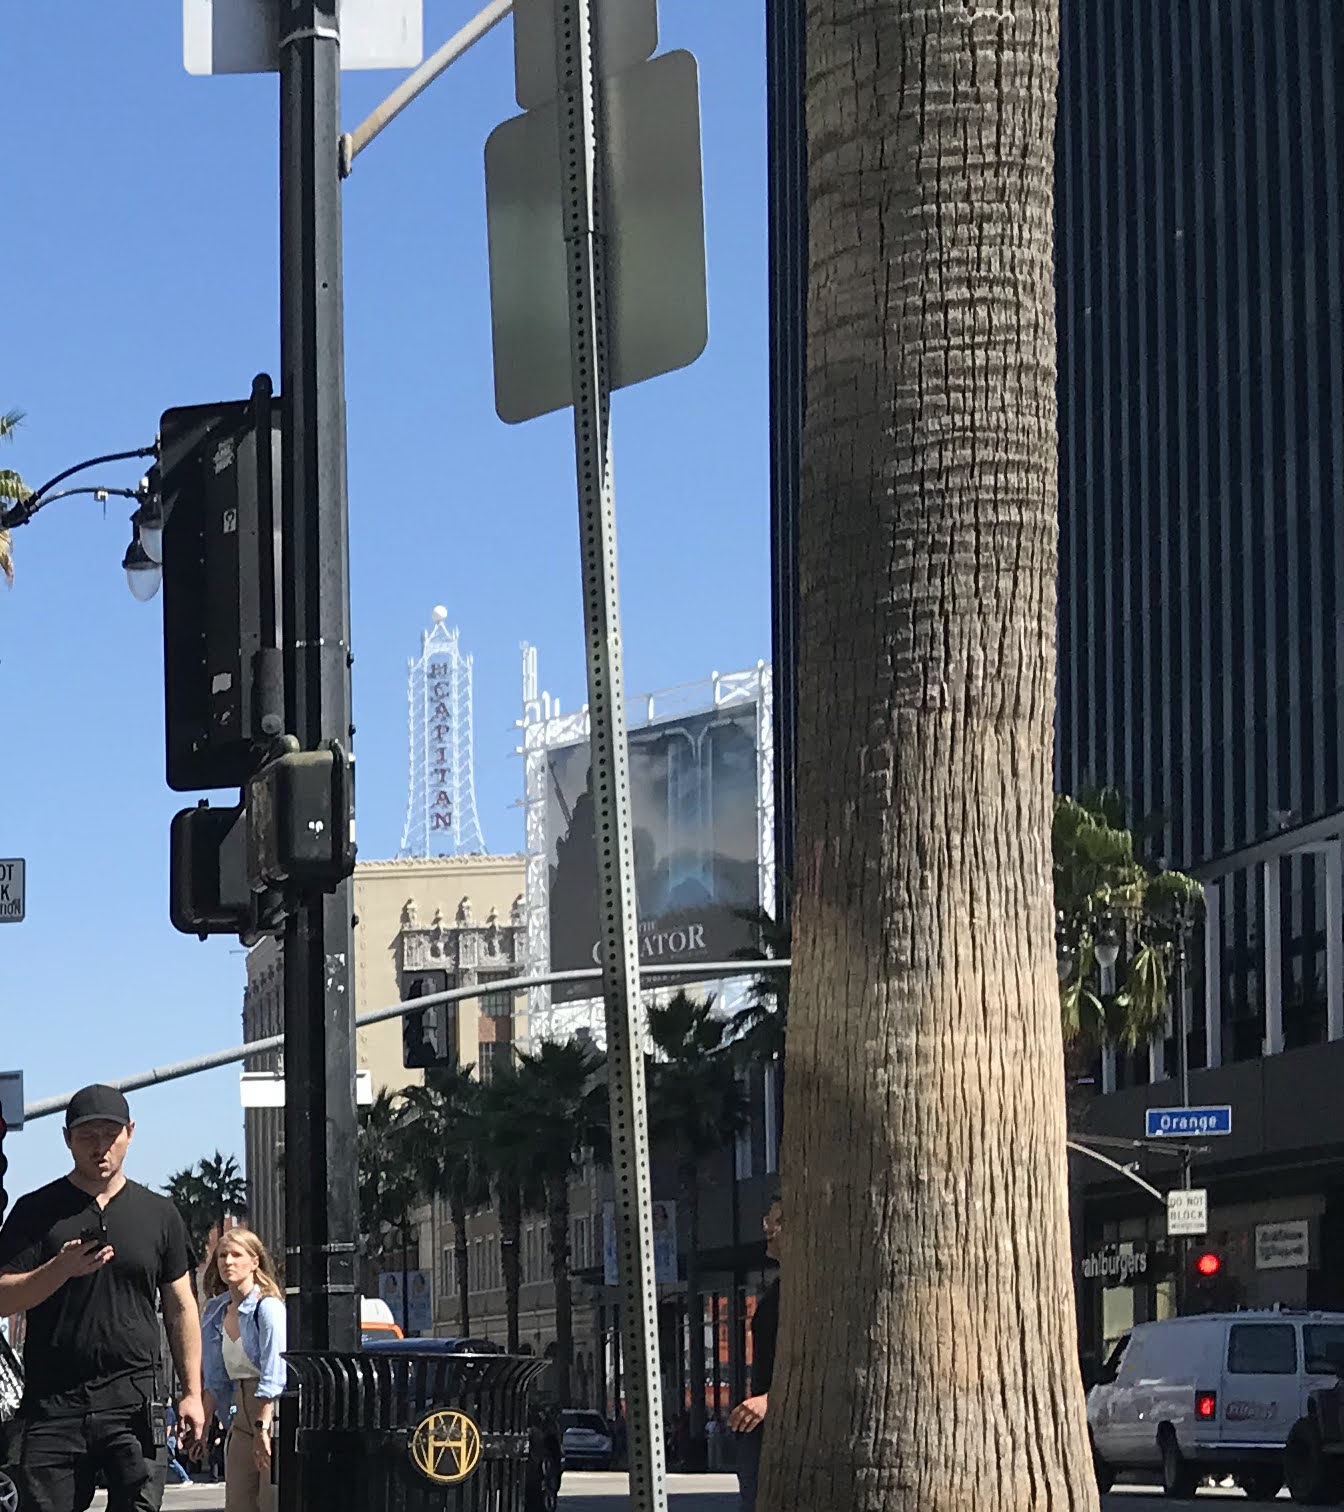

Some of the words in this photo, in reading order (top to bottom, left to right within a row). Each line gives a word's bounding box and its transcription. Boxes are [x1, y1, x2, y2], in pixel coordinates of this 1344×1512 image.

[429, 681, 453, 831] CAPITAN
[1161, 1114, 1216, 1132] Orange
[1187, 1196, 1203, 1206] NOT
[1170, 1209, 1203, 1220] BLOCK
[1081, 1251, 1147, 1282] ahlburgers
